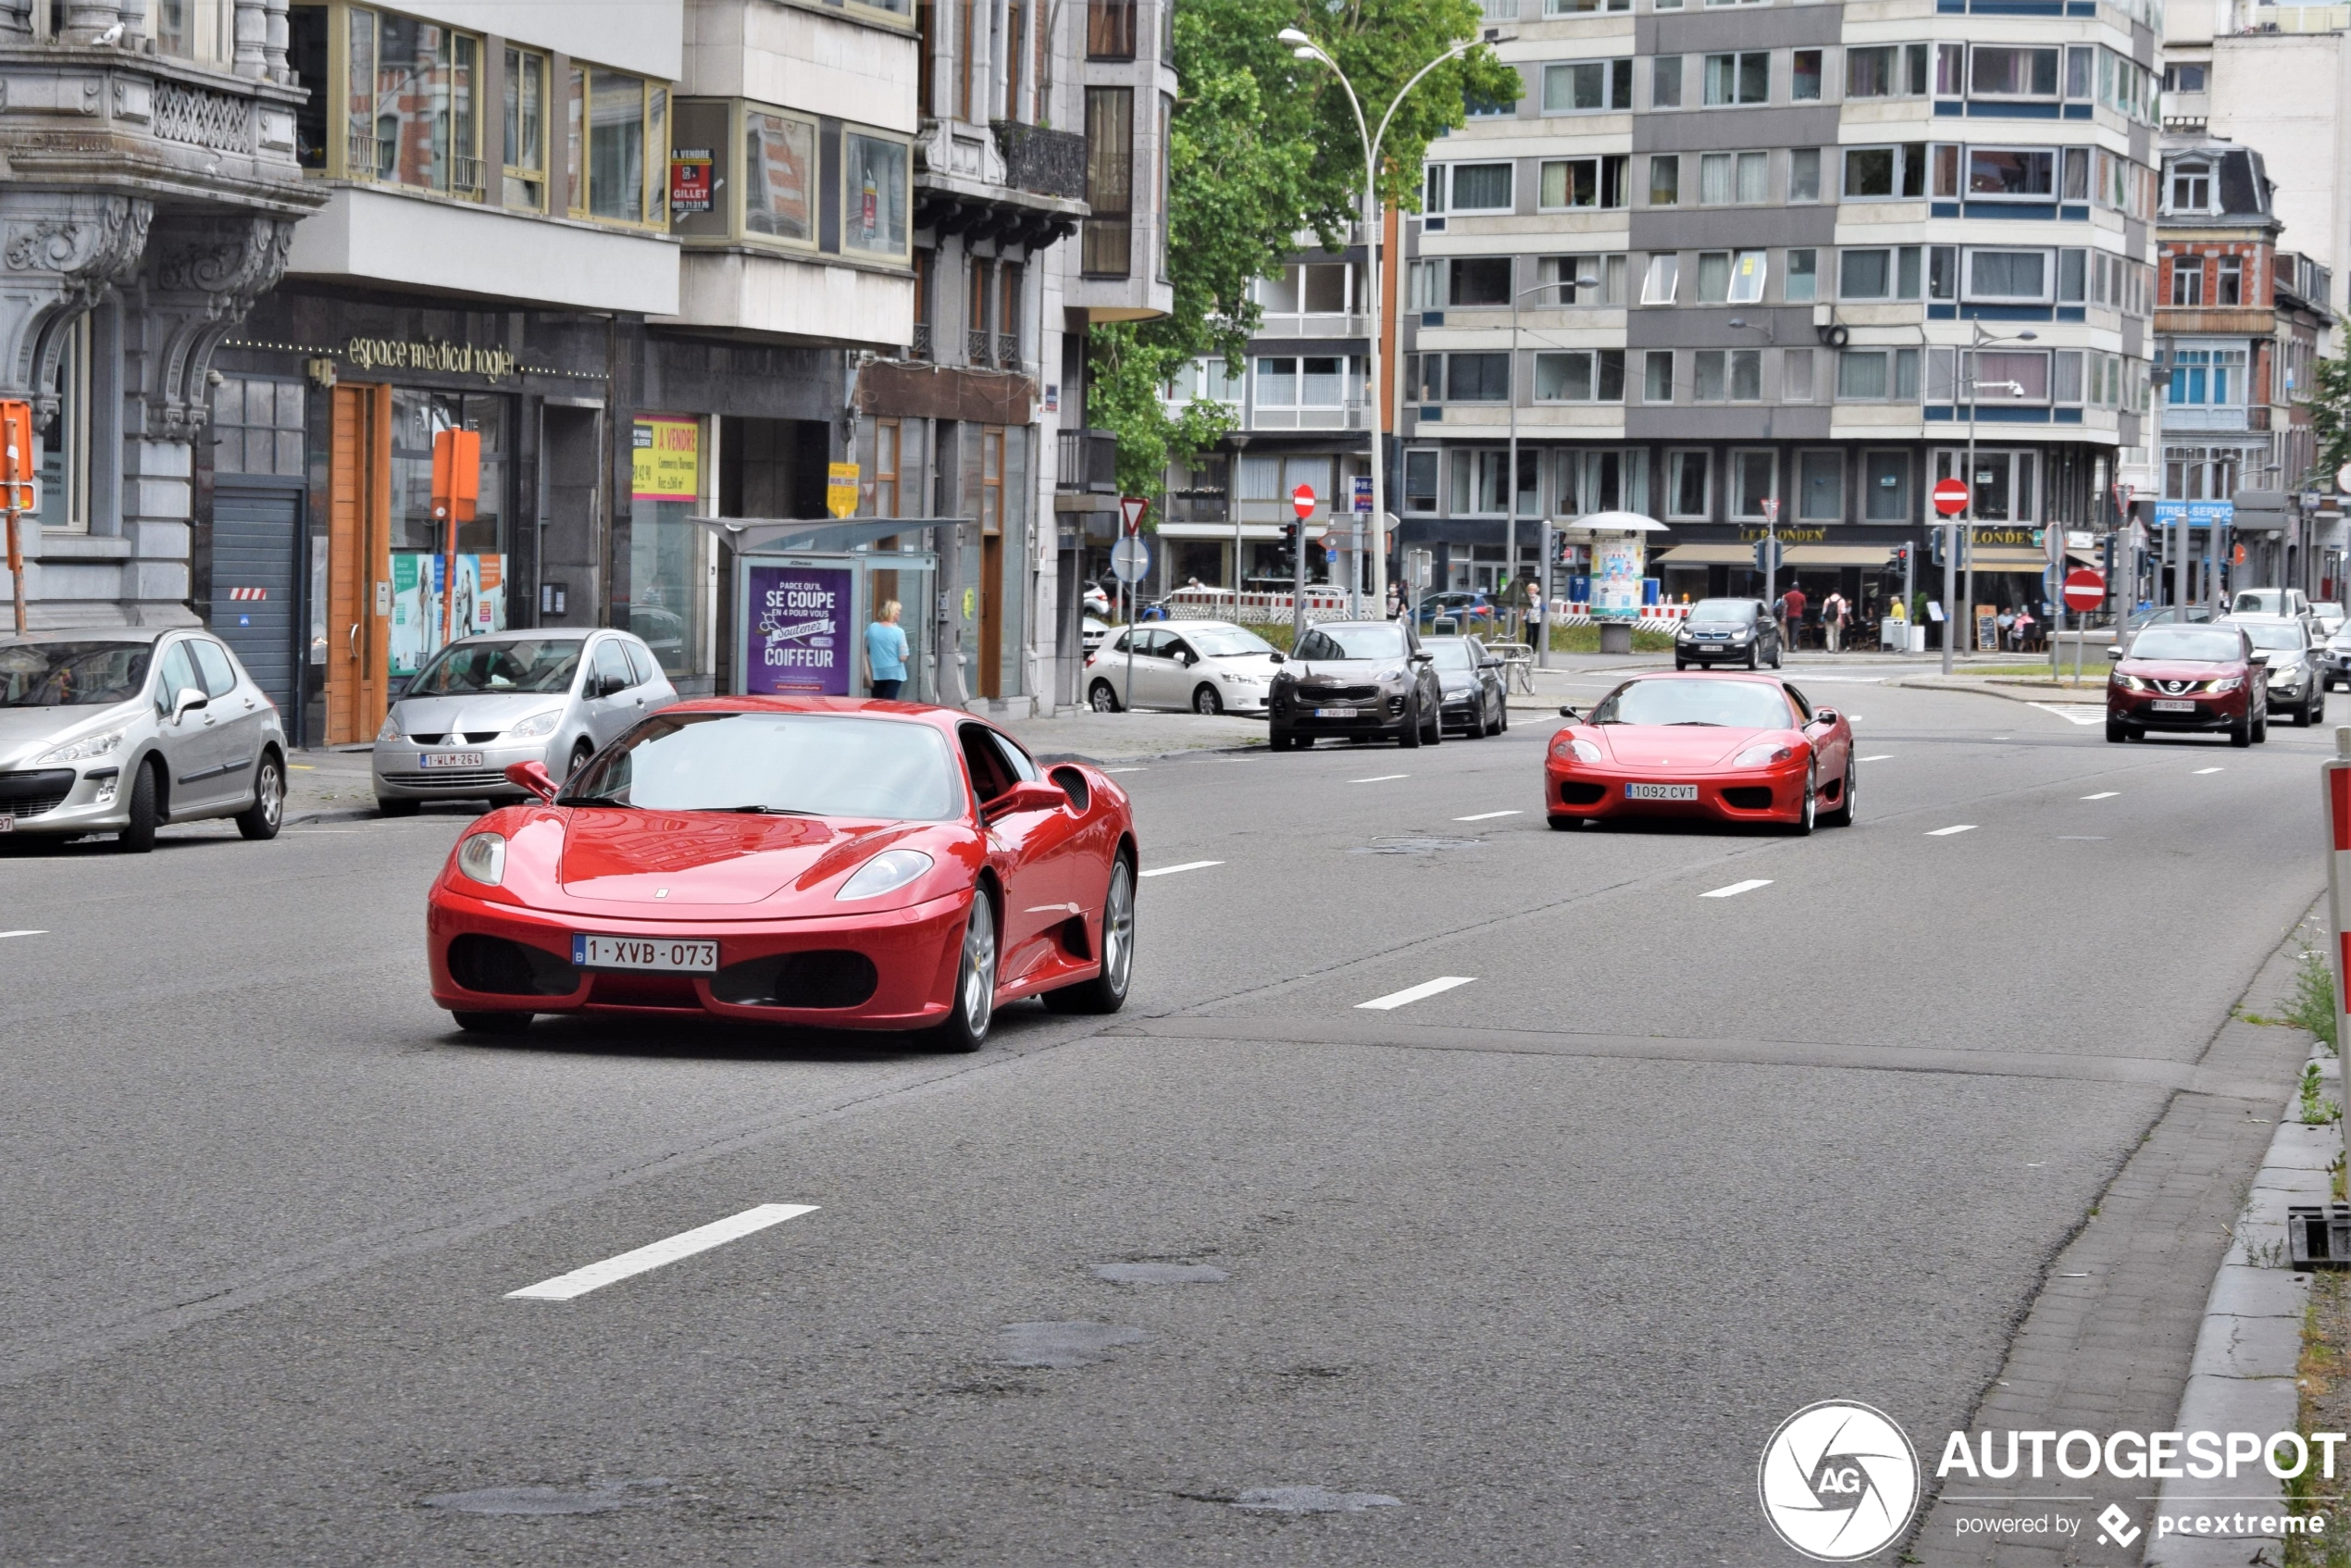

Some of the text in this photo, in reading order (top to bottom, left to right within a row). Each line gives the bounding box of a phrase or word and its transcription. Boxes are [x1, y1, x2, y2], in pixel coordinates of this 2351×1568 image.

[672, 150, 710, 158] A VENDRE
[673, 189, 708, 198] GILLET
[349, 333, 515, 384] espace médical rogier
[658, 428, 696, 453] A VENDRE
[2156, 505, 2233, 516] ITRES-SERVIC
[1740, 529, 1824, 541] LE BONDEN
[1964, 531, 2034, 544] LONDEN
[779, 581, 822, 591] PARCE QU'IL
[765, 591, 836, 609] SE COUPE
[771, 608, 782, 616] EN
[789, 609, 808, 617] POUR
[777, 621, 822, 639] Soutenez
[764, 648, 834, 667] COIFFEUR
[429, 754, 479, 765] 1-WLM-264
[1636, 785, 1695, 799] 1092 CVT
[575, 940, 714, 966] B 1-XVB-073
